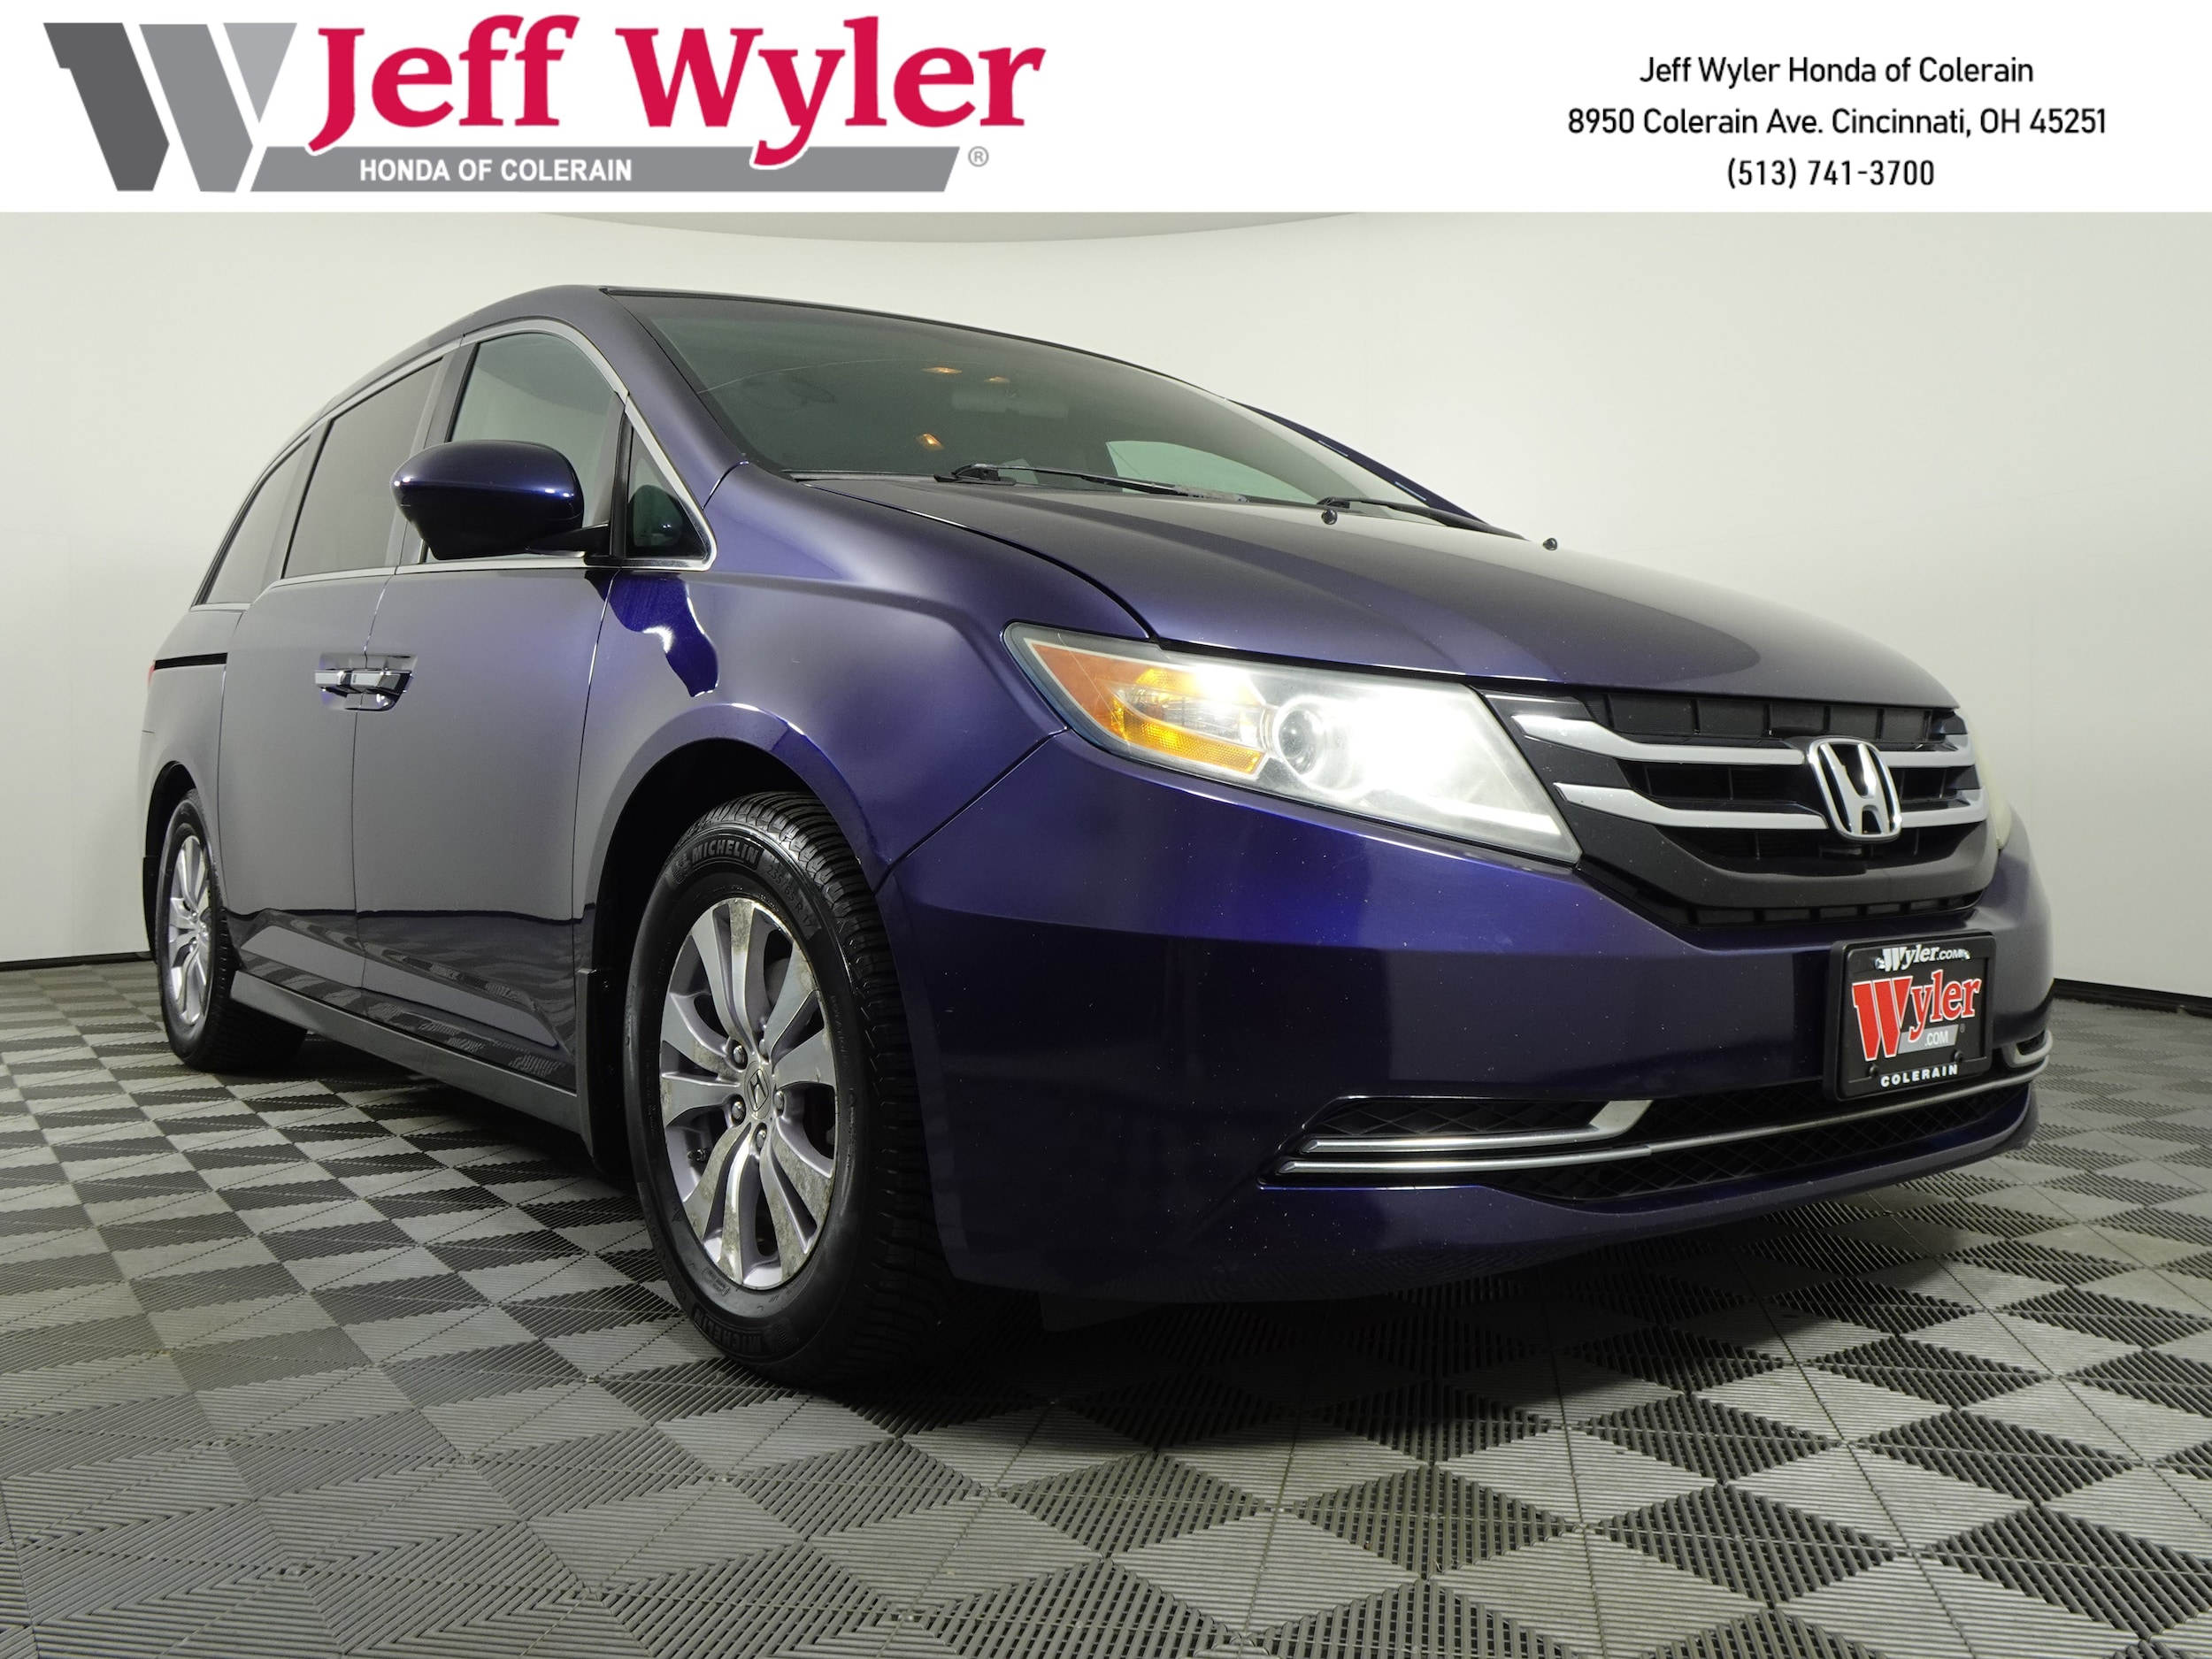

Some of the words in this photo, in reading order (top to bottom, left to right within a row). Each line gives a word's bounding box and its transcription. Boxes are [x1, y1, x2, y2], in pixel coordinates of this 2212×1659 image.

[692, 839, 759, 864] MICHELIN
[1852, 969, 1982, 1062] Wyler
[1880, 1064, 1958, 1087] COLERAIN
